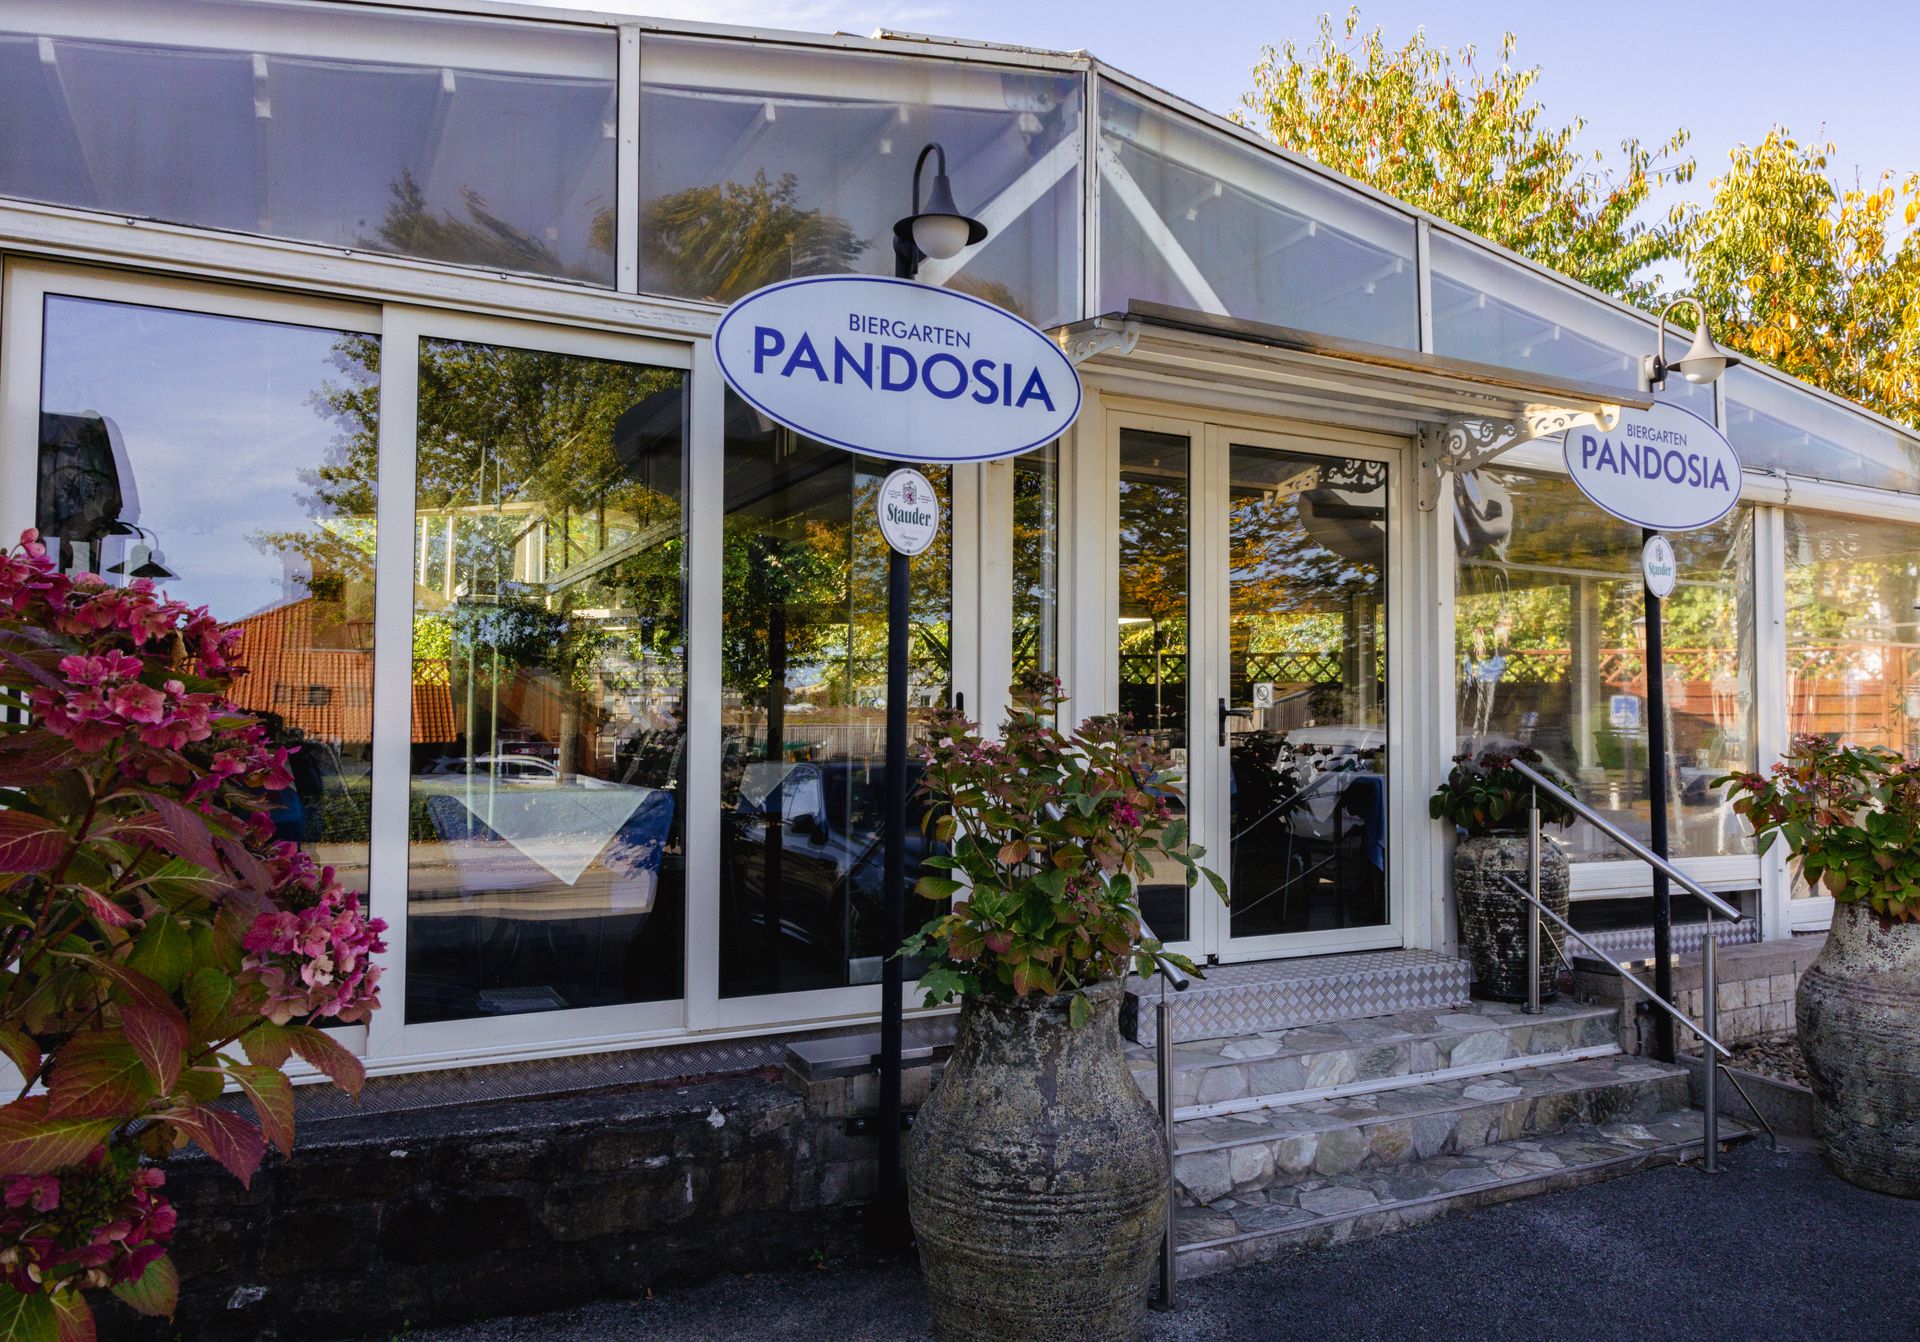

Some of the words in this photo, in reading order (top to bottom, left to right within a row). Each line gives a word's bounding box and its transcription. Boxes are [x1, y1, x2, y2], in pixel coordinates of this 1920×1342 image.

[849, 314, 970, 349] BIERGARTEN
[753, 325, 1056, 412] PANDOSIA
[1627, 424, 1687, 446] BIERGARTEN
[1582, 434, 1730, 491] PANDOSIA
[887, 503, 931, 527] Stauder
[1648, 562, 1671, 577] Stauder
